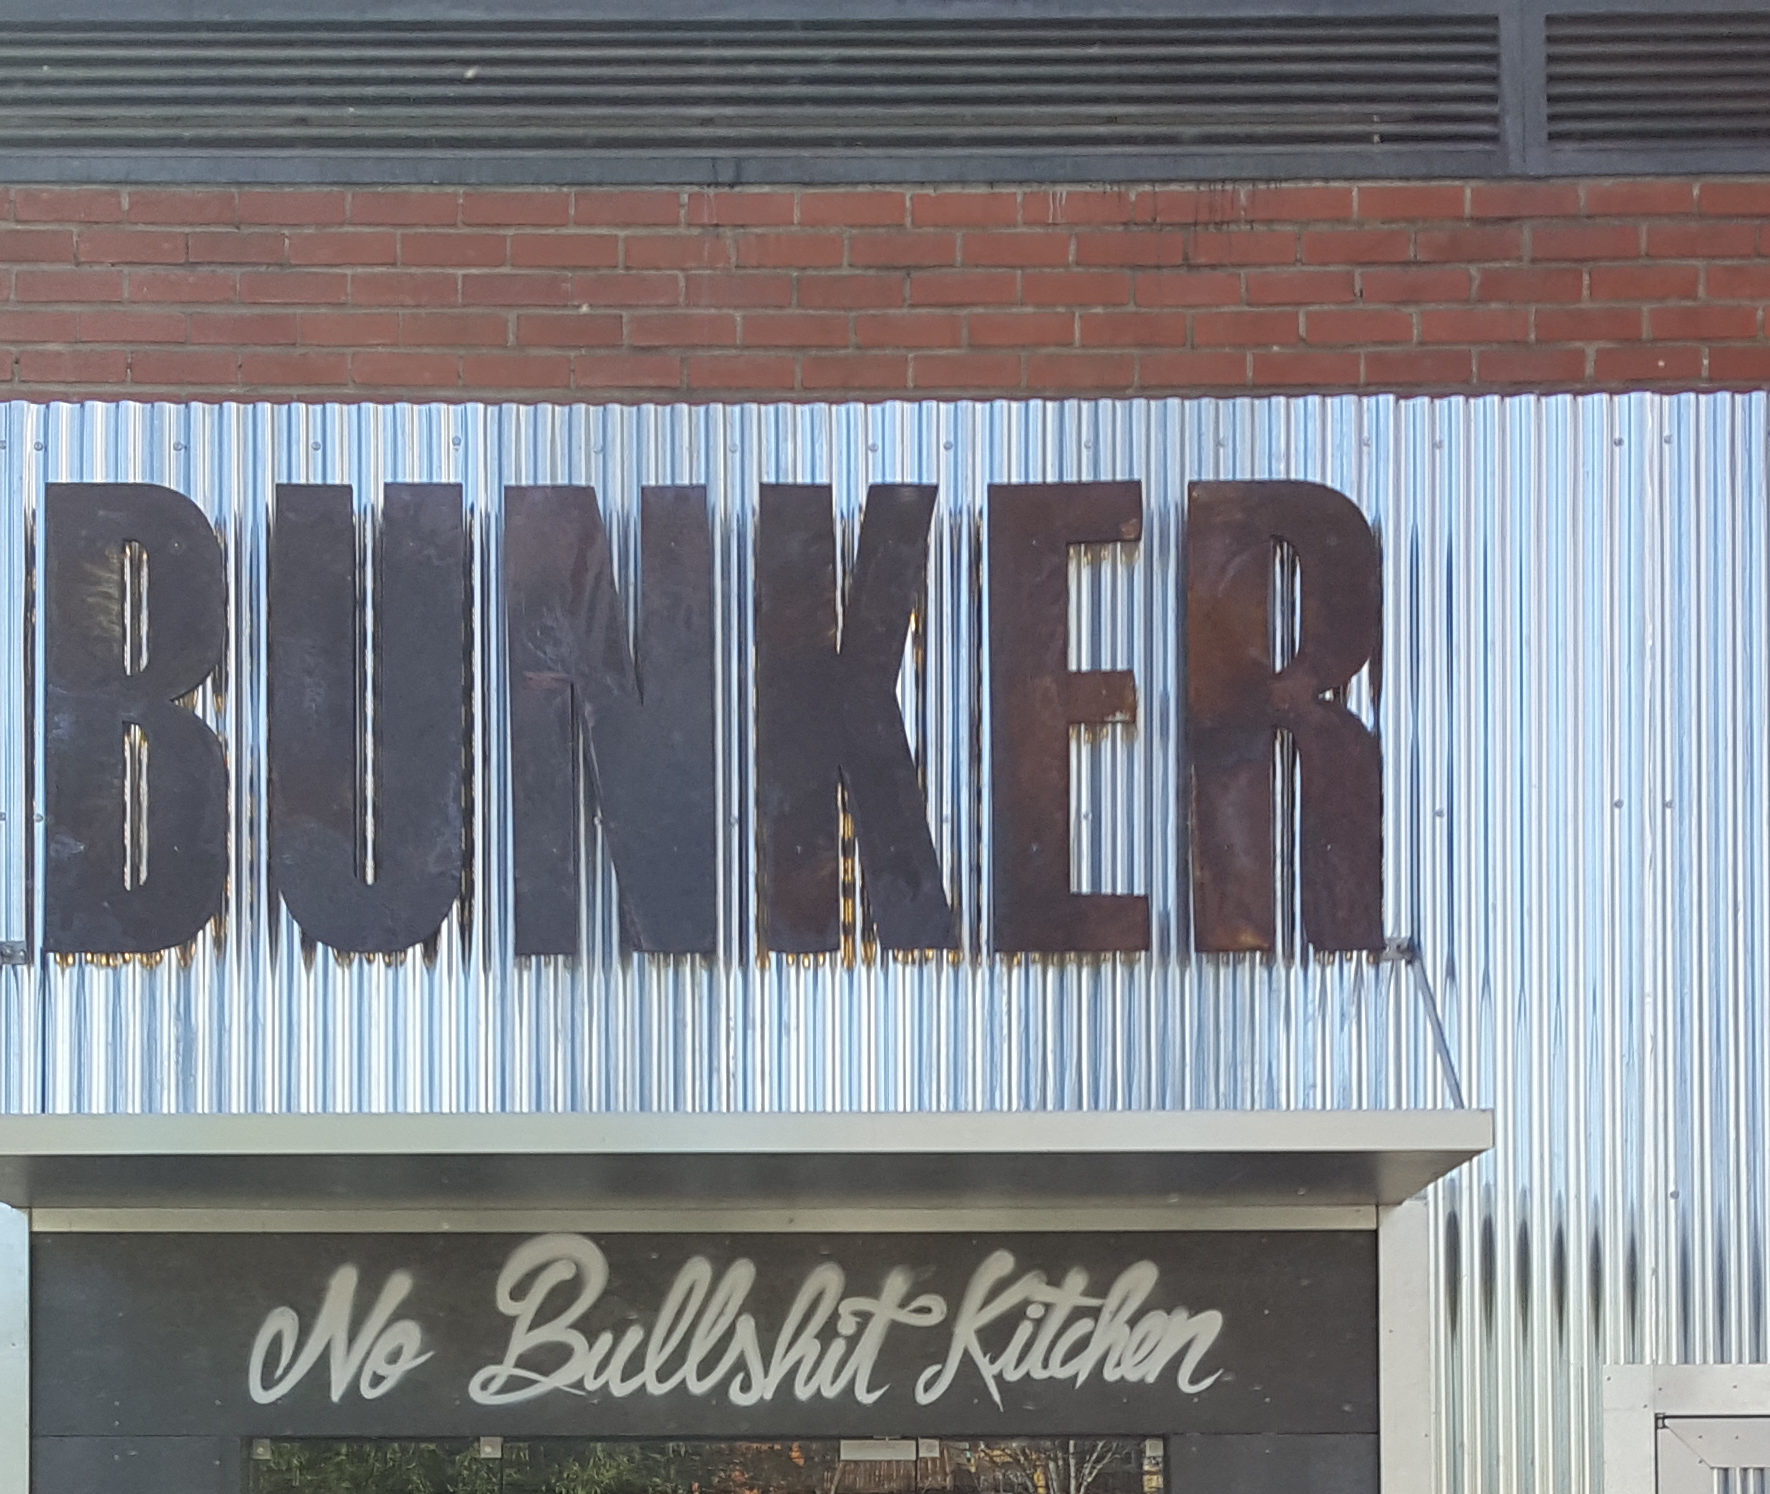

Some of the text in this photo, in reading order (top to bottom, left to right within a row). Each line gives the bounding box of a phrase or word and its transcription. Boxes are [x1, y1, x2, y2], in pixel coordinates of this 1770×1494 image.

[44, 480, 1385, 955] BUNKER
[248, 1232, 1223, 1412] No Bullshit Kitchen
